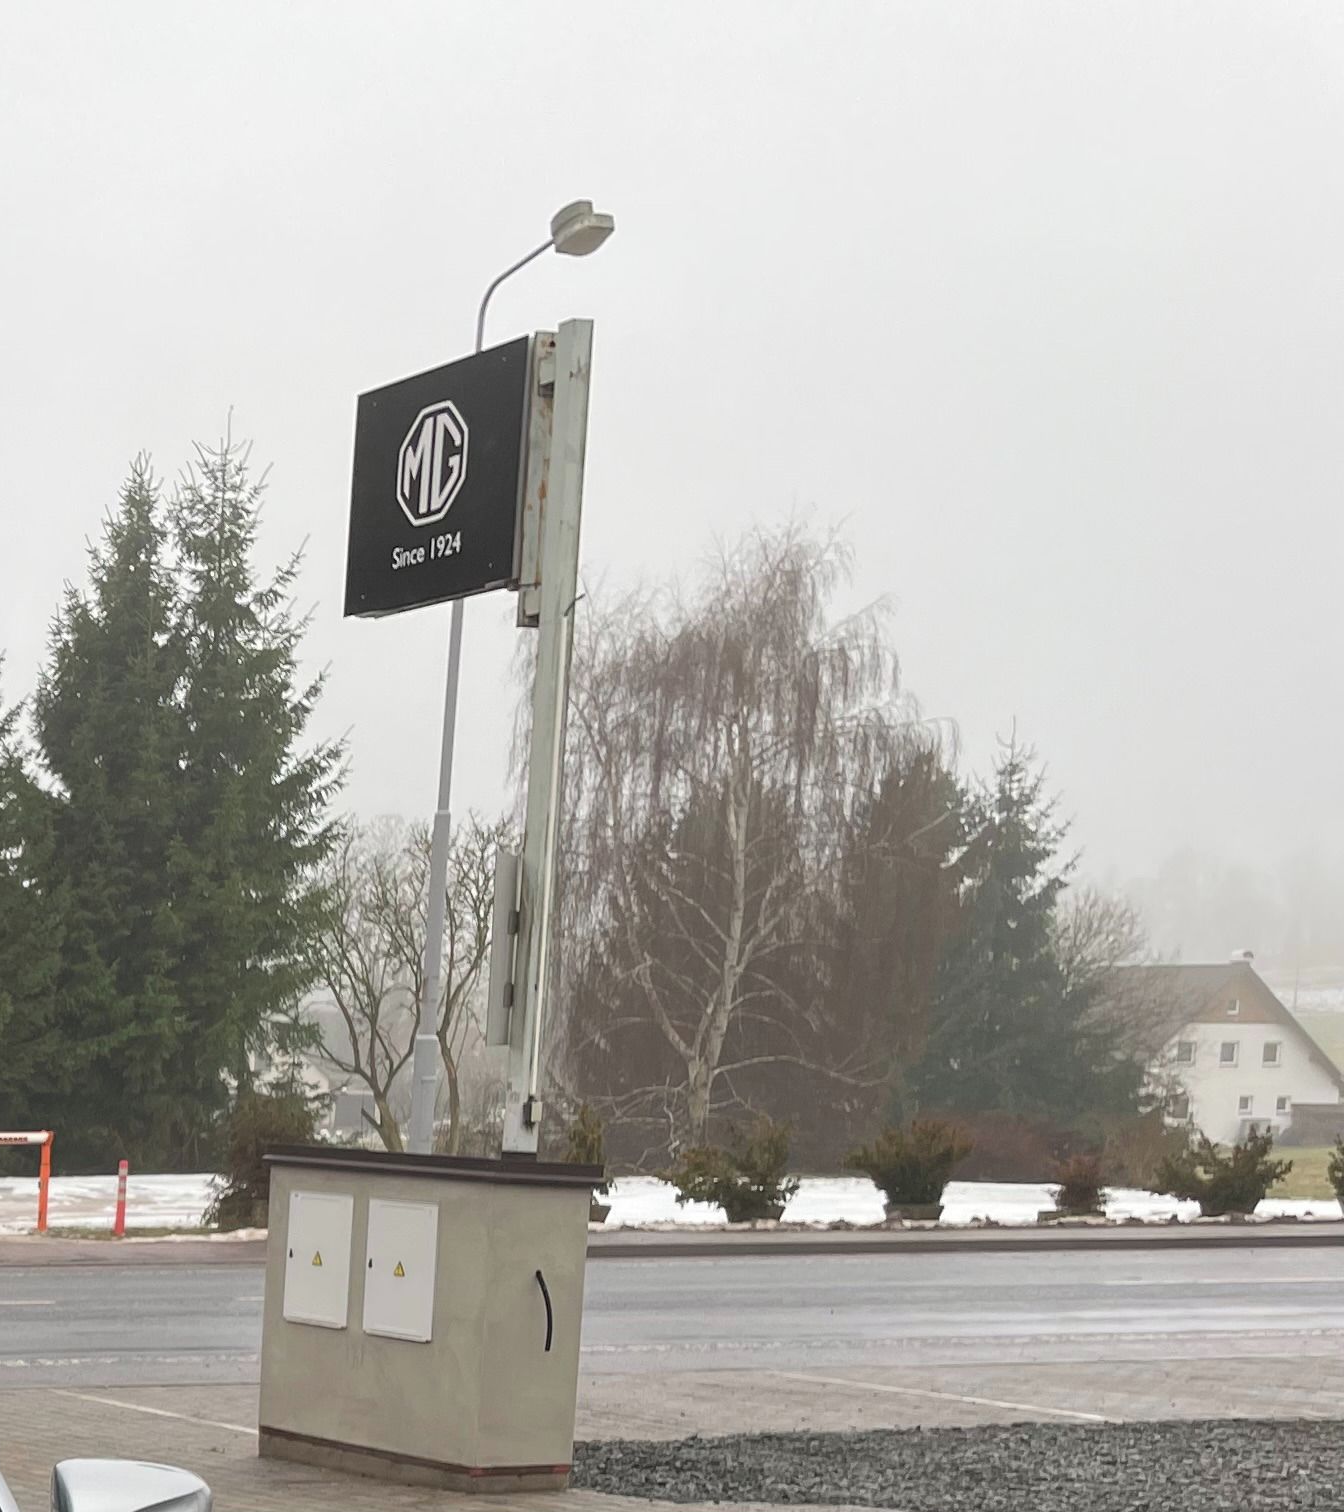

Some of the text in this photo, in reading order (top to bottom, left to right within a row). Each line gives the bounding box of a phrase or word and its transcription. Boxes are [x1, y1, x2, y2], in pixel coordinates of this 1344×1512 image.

[402, 411, 463, 515] MG
[391, 530, 462, 570] Since 1924
